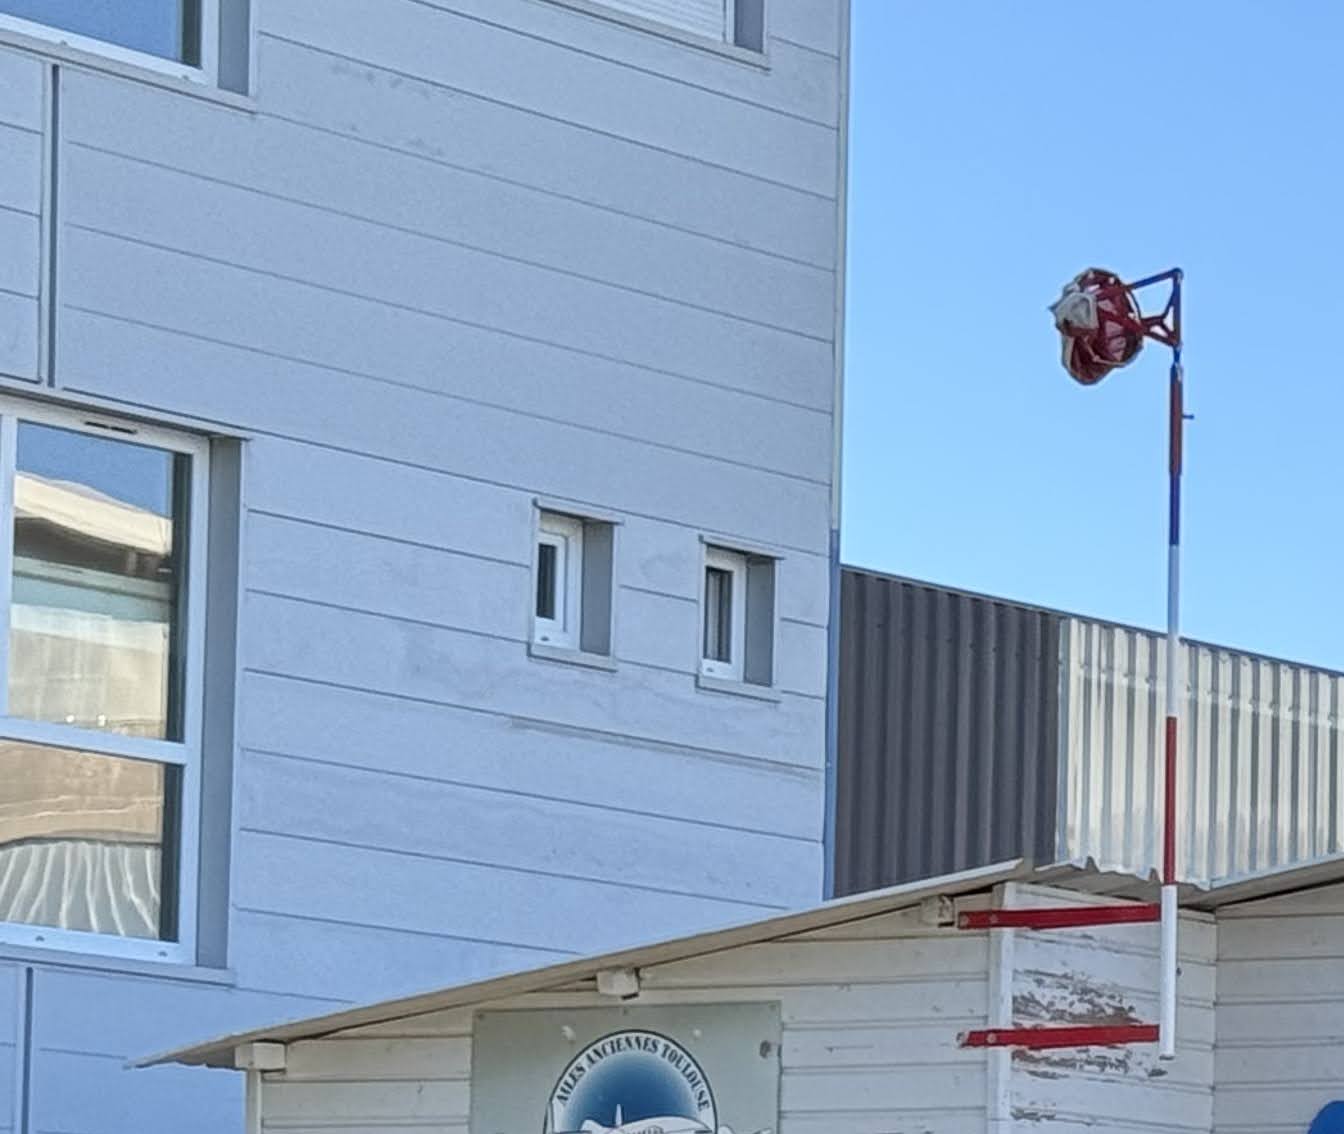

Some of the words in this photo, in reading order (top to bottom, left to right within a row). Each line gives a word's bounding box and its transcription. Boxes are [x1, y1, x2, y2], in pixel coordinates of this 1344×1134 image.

[556, 1062, 586, 1106] AILES
[586, 1036, 660, 1068] ANCIENNES
[660, 1042, 711, 1112] TOULOUSE
